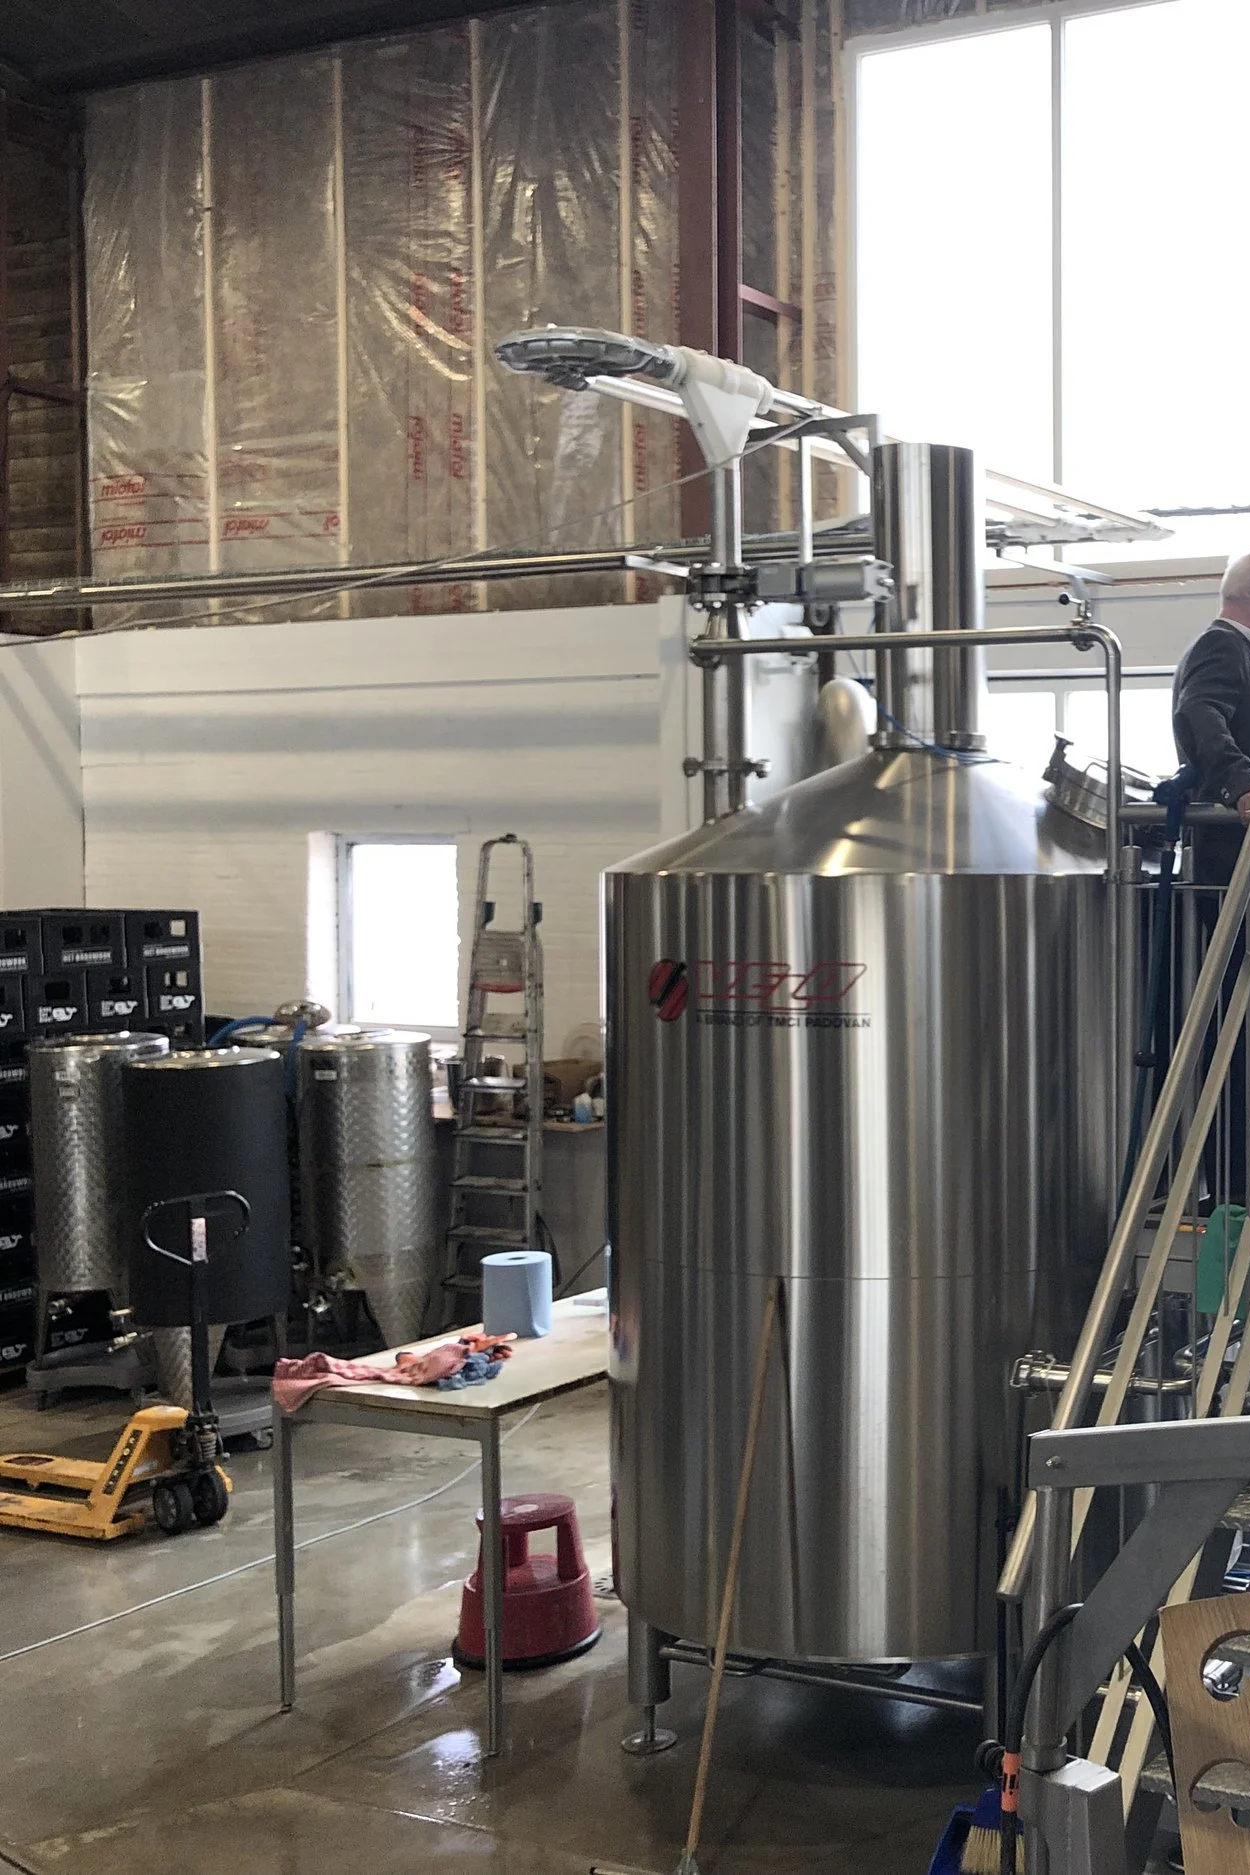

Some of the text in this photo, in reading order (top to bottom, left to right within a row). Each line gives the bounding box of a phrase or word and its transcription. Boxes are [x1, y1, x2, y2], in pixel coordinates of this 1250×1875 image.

[697, 960, 868, 1011] VELO
[767, 1016, 801, 1028] TMCI
[806, 1017, 871, 1029] PADOVAN
